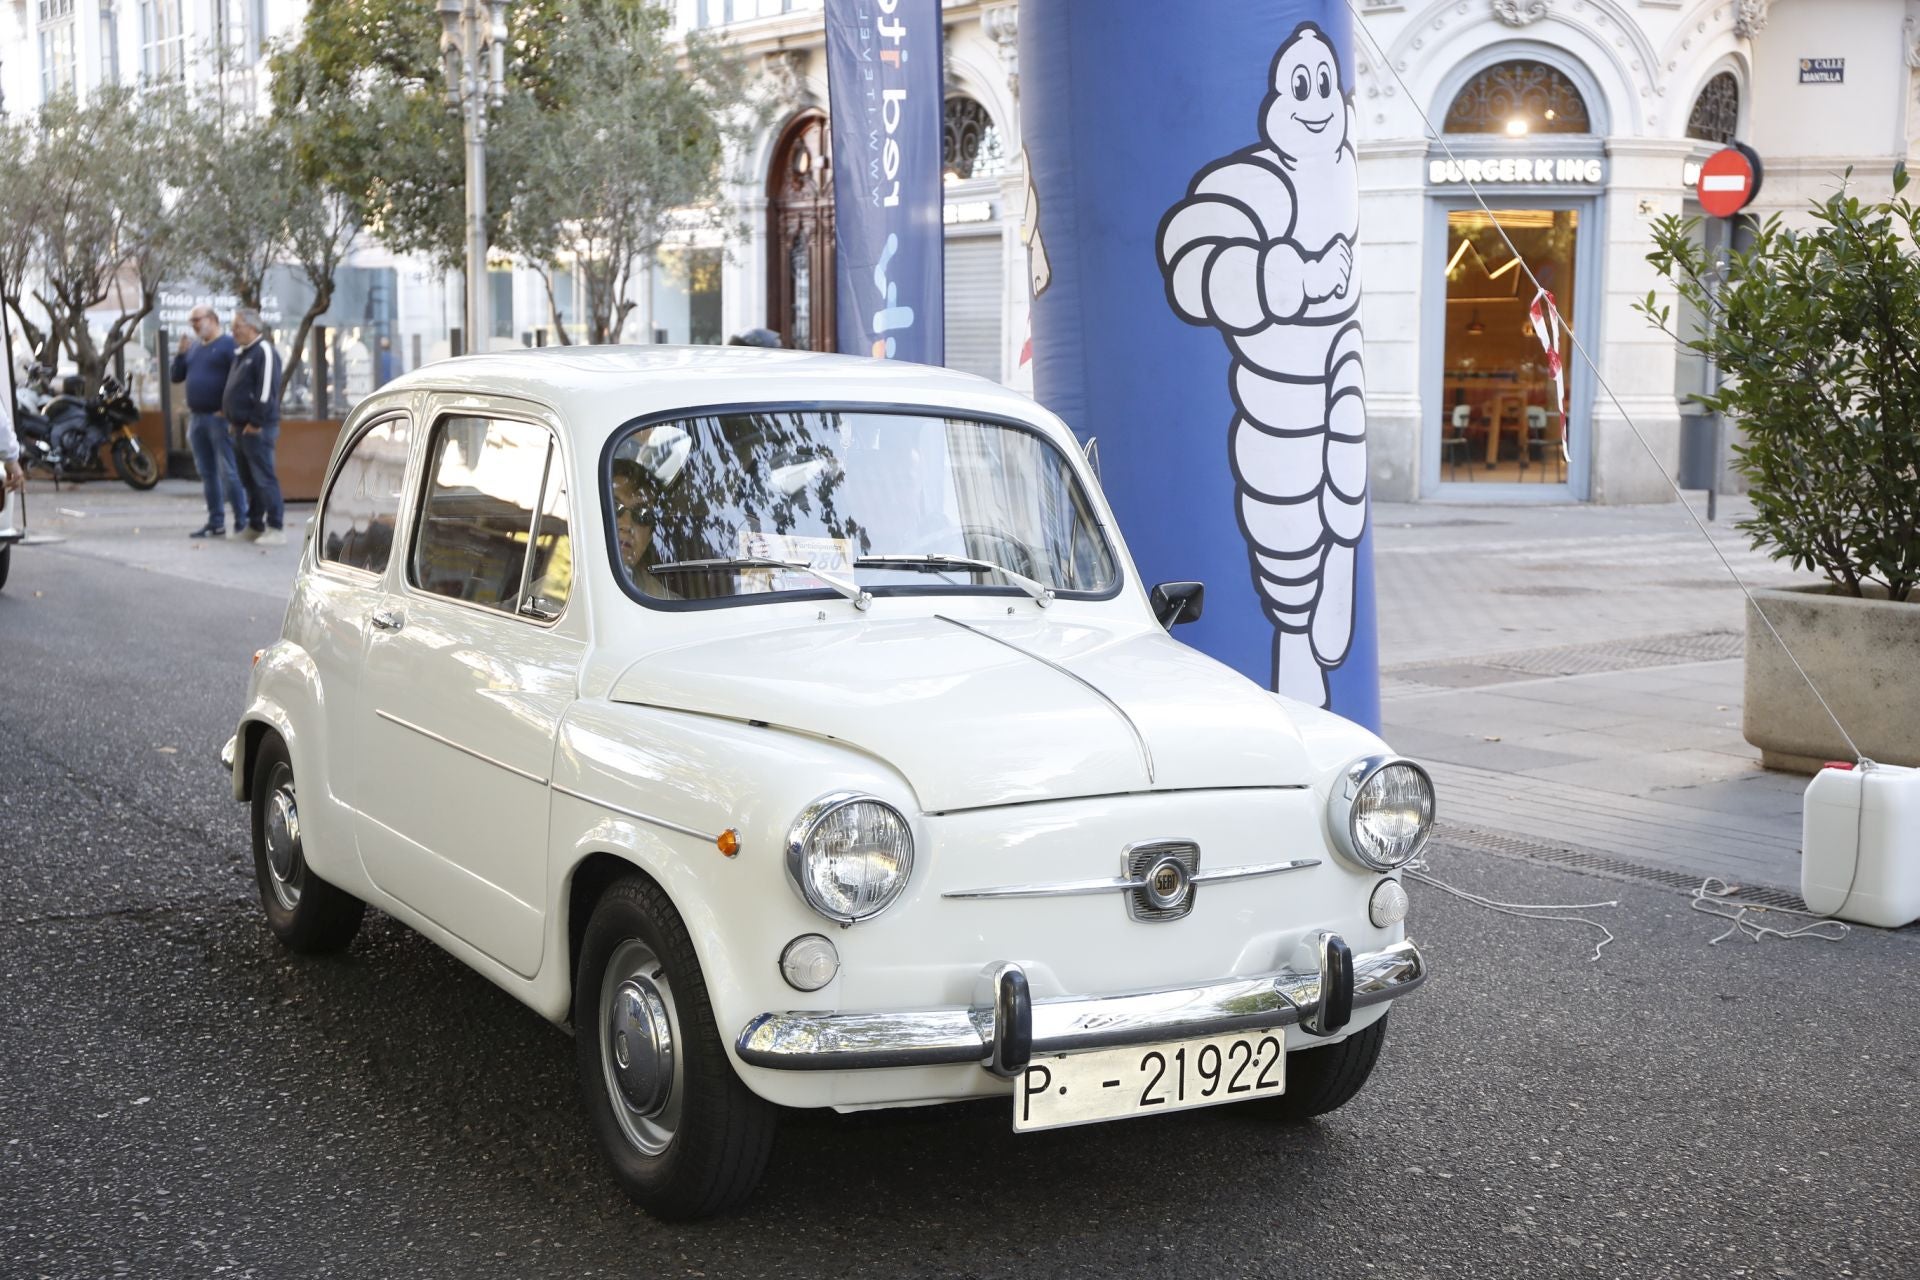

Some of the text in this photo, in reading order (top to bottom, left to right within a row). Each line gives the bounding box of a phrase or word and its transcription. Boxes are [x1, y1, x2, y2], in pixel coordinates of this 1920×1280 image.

[1814, 59, 1844, 69] CALLE
[1802, 71, 1841, 82] MANTILLA
[1429, 159, 1602, 183] BURGER KING
[1157, 874, 1177, 890] SEAT
